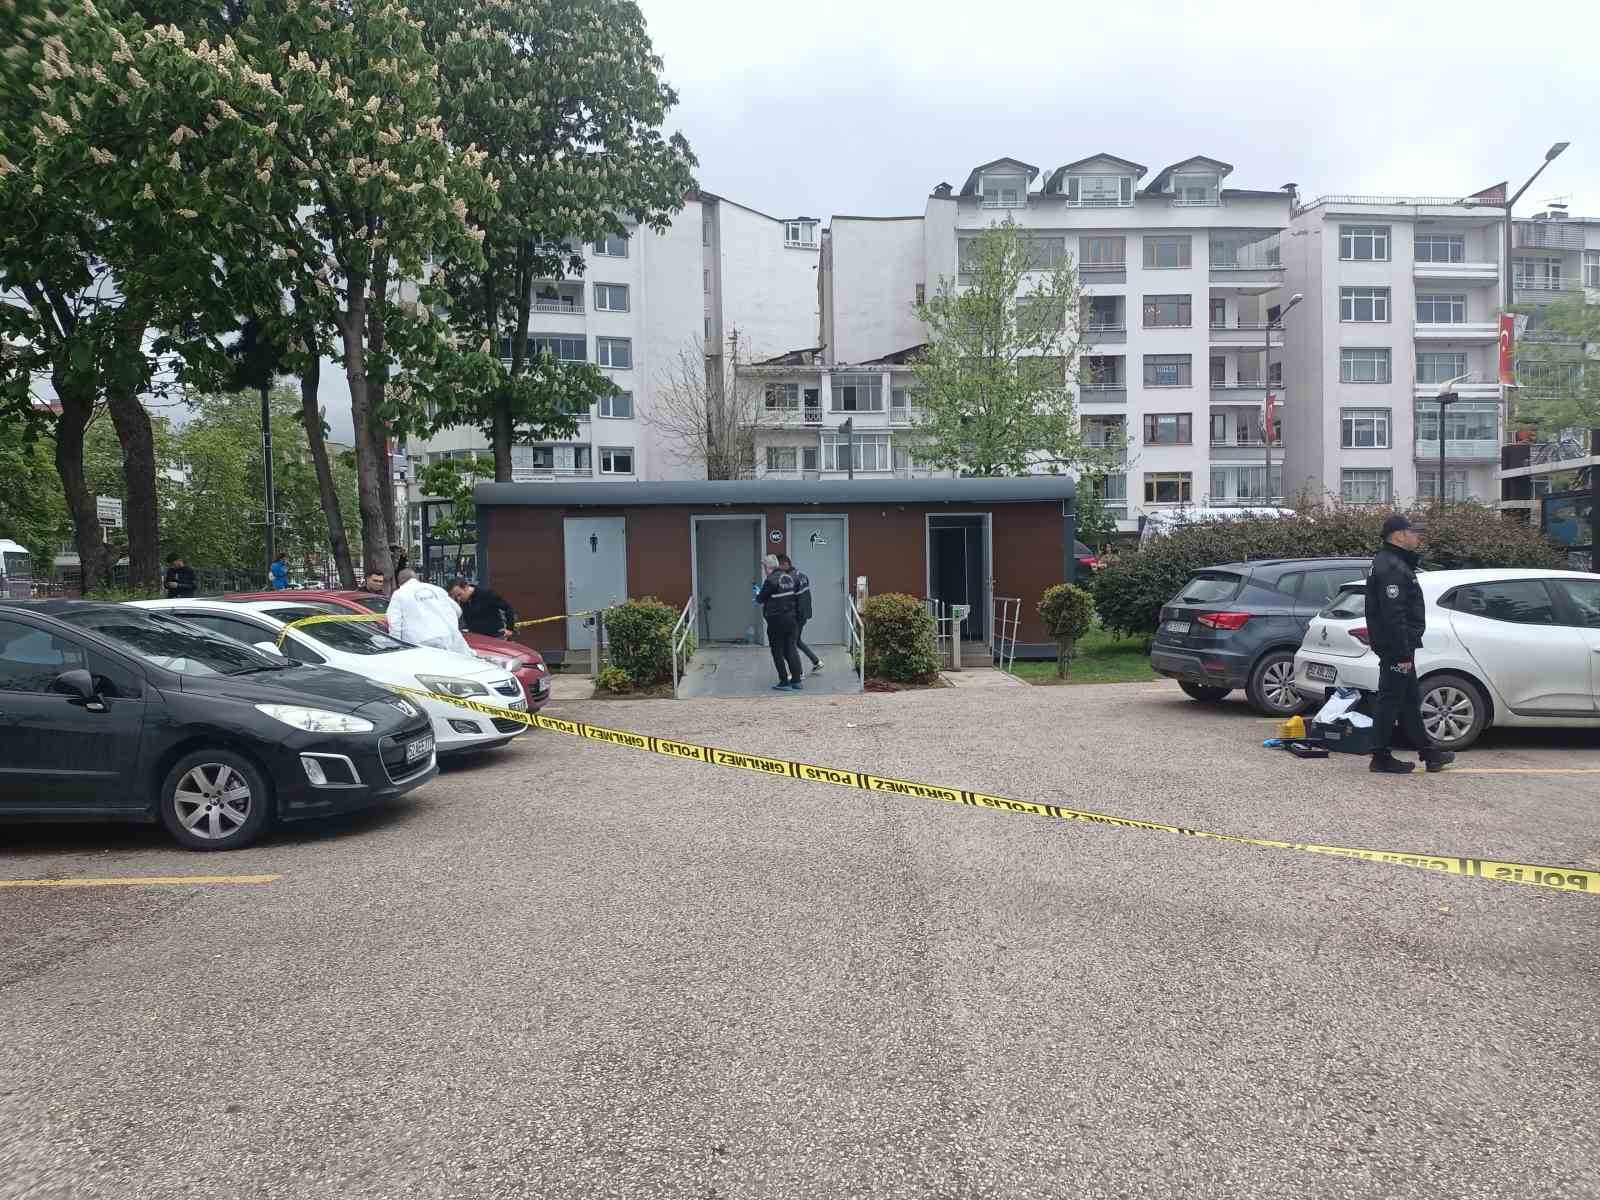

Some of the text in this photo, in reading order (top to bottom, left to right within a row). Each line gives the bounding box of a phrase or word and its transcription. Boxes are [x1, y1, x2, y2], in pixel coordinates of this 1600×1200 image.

[541, 717, 574, 732] POLİS
[588, 728, 644, 748] GİRİLMEZ
[661, 741, 699, 759] POLİS
[717, 753, 784, 774] GİRİLMEZ
[806, 768, 852, 785] POLİS
[874, 779, 956, 801] GİRİLMEZ
